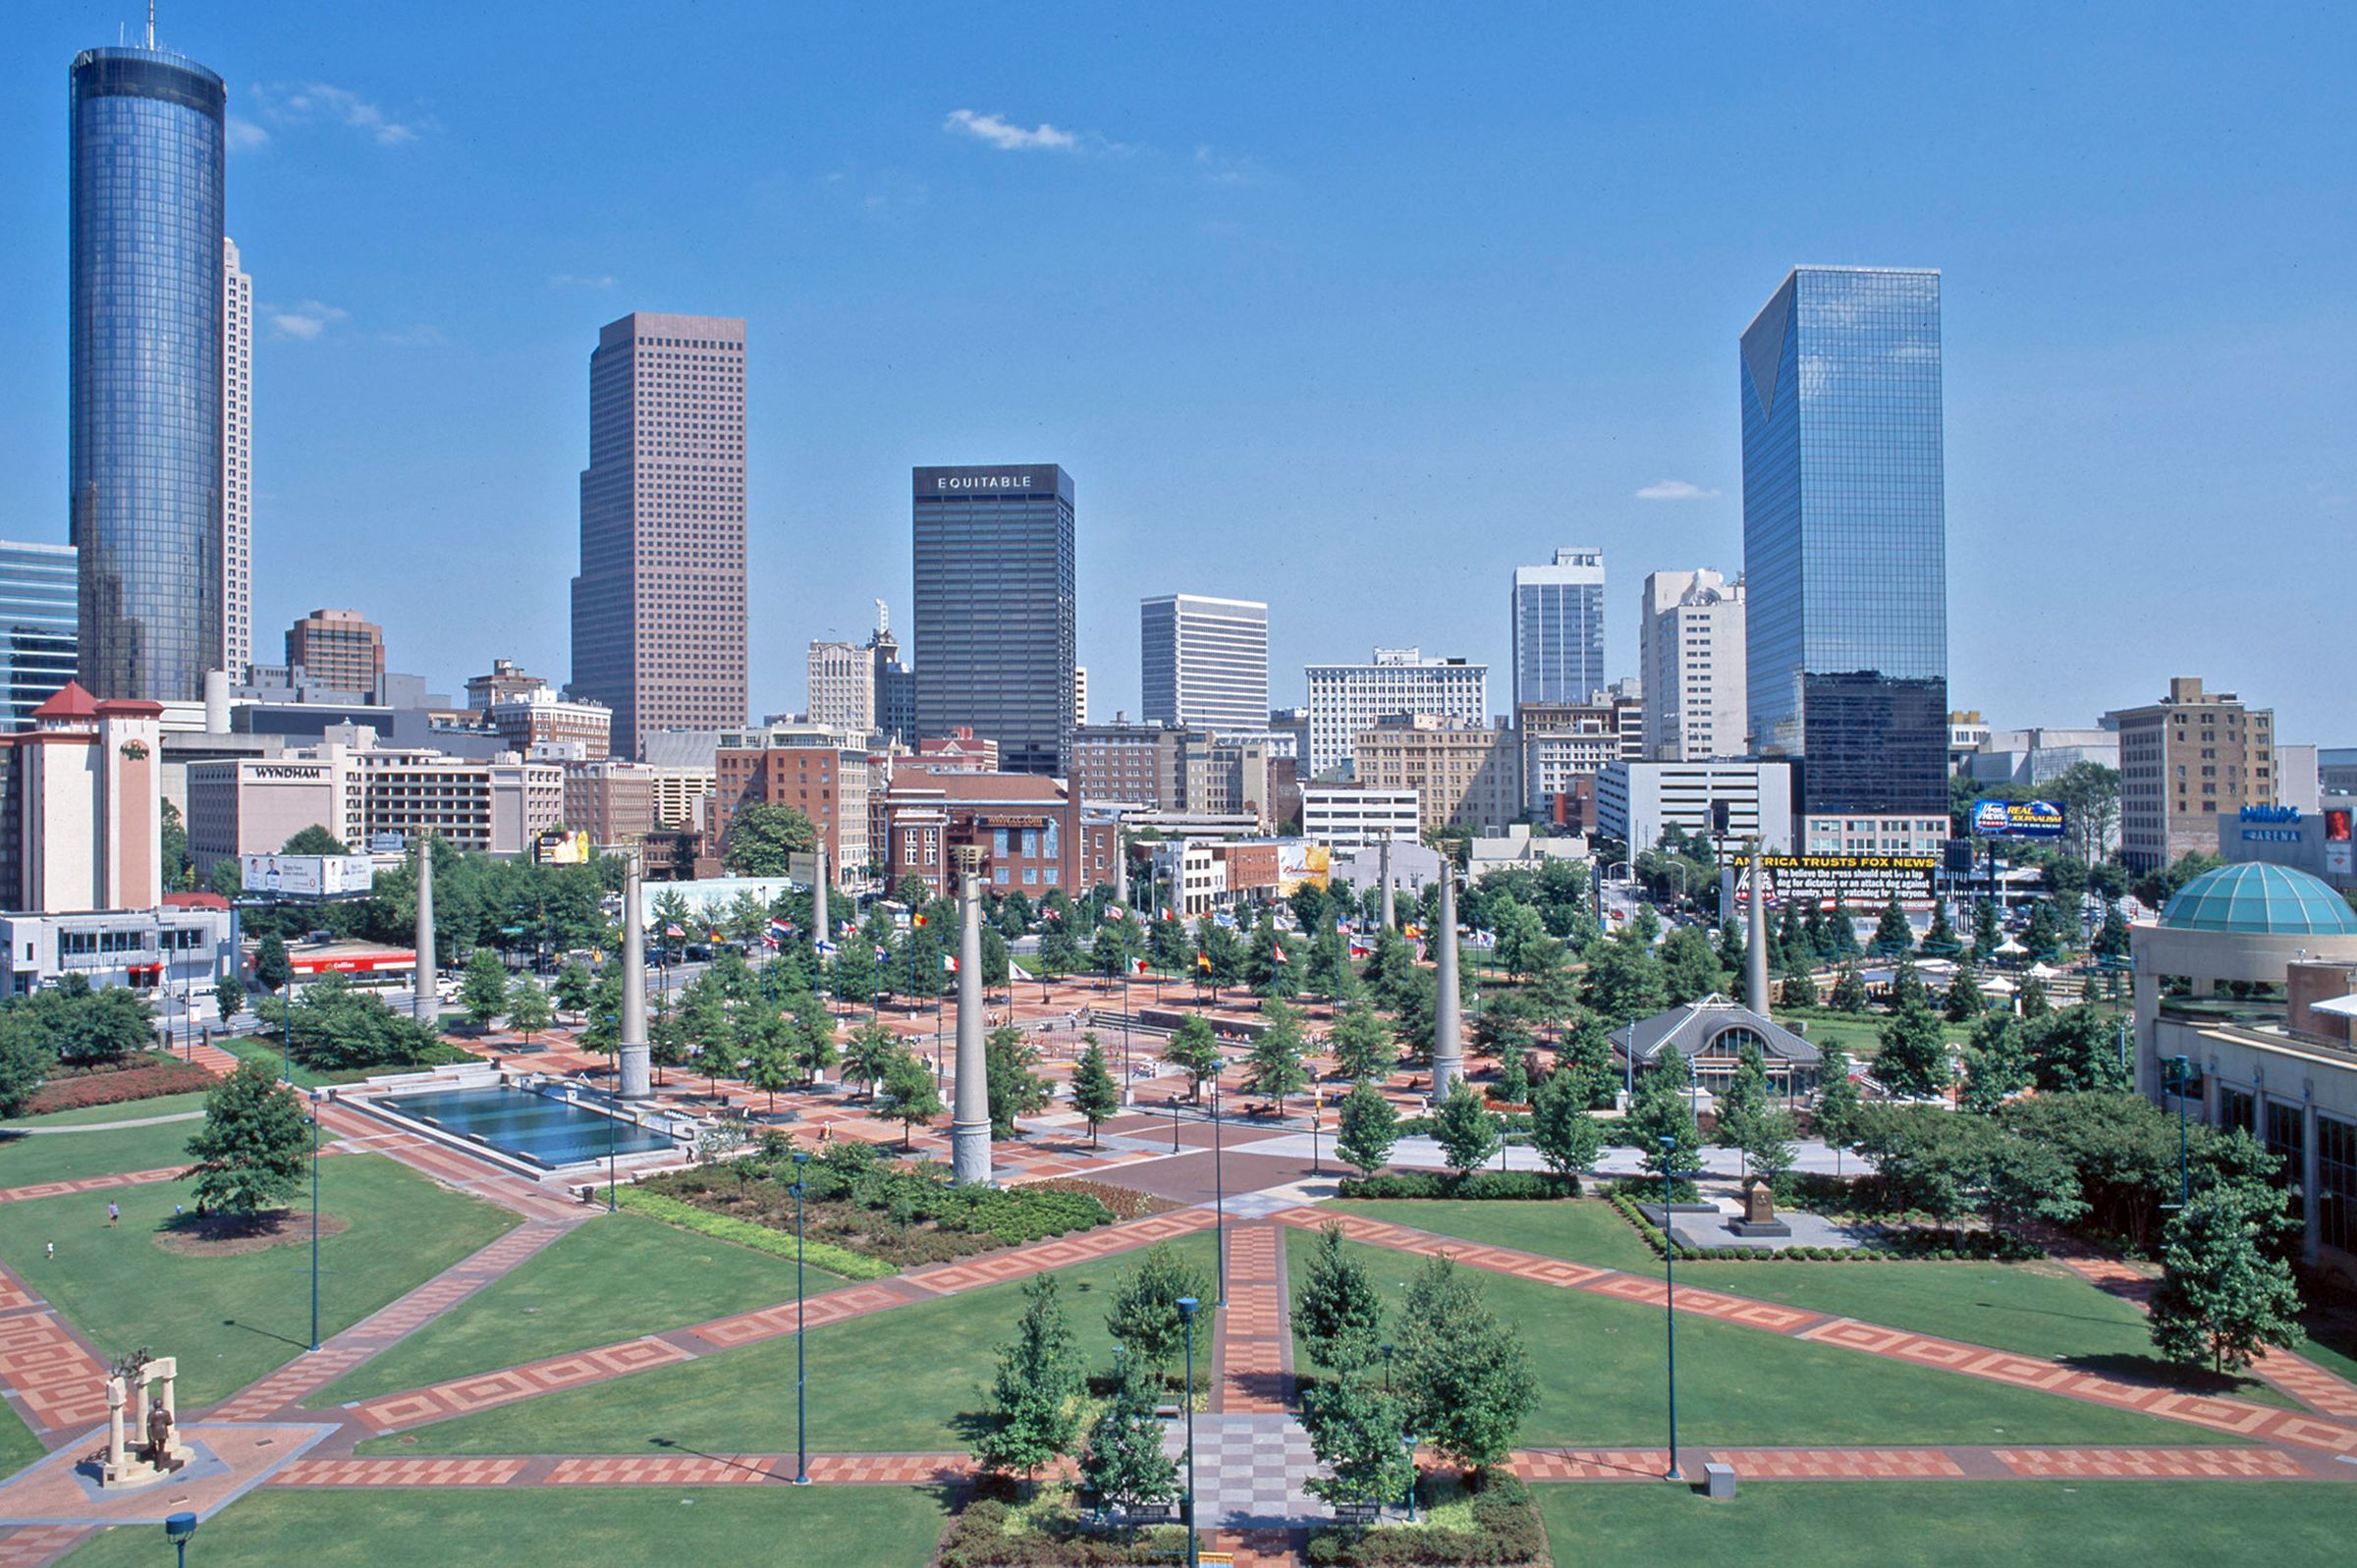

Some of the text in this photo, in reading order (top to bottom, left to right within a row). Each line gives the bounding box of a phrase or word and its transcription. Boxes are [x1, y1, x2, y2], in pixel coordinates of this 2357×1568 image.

[938, 476, 1031, 488] EQUITABLE
[255, 768, 320, 779] WYNDHAM
[2257, 832, 2298, 841] ARENA
[1734, 856, 1935, 868] ARICA TRUSTS FOX NEWS
[1777, 869, 1788, 878] We
[1789, 868, 1816, 878] believe
[1817, 869, 1830, 878] the
[1832, 870, 1852, 880] press
[1853, 869, 1879, 879] should
[1880, 869, 1892, 879] not
[1911, 869, 1924, 880] lap
[1777, 879, 1791, 889] dog
[1792, 879, 1803, 888] for
[1804, 879, 1837, 888] dictators
[1860, 879, 1885, 888] attack
[1886, 879, 1900, 890] dog
[1901, 880, 1930, 890] against
[1790, 889, 1822, 898] country,
[1823, 889, 1836, 897] but
[1842, 889, 1880, 899] watchdog
[1881, 889, 1891, 897] for
